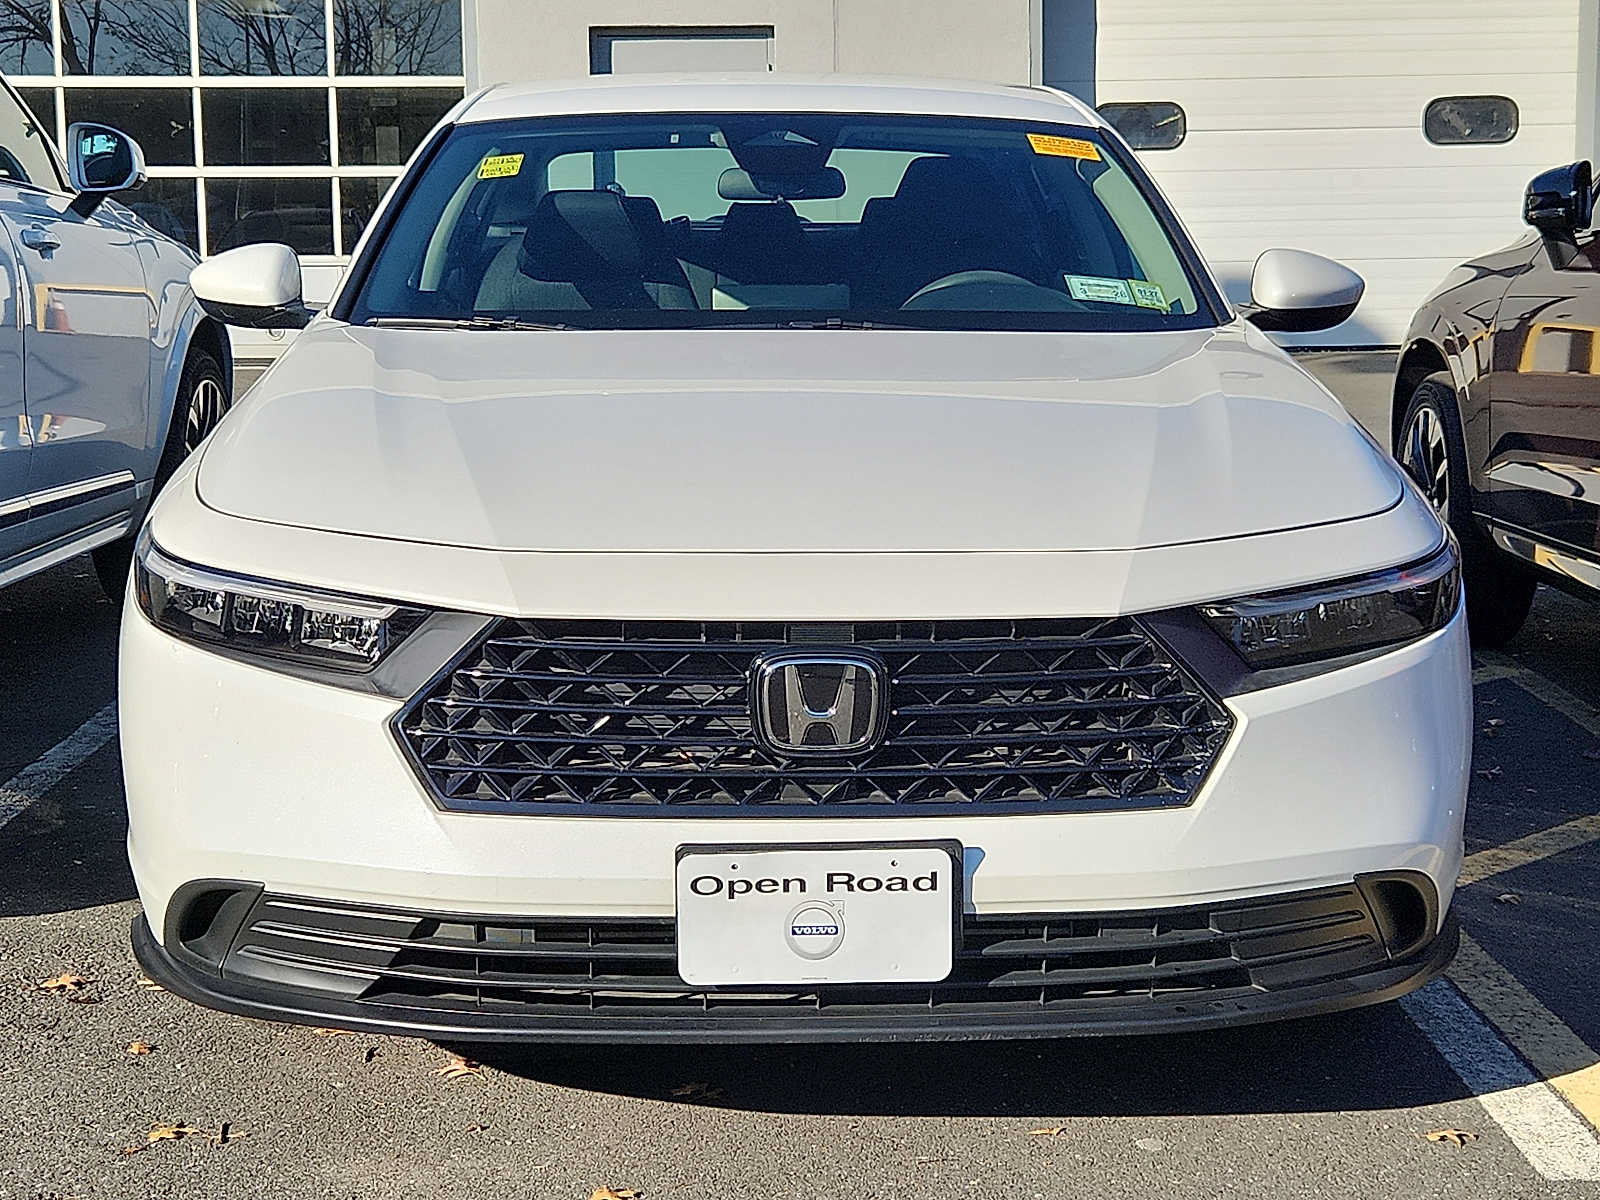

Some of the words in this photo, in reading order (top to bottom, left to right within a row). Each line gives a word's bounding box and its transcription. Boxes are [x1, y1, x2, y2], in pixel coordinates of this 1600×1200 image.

[784, 664, 857, 746] H
[690, 875, 807, 900] Open
[826, 871, 938, 893] Road
[793, 926, 837, 935] VOLVO
